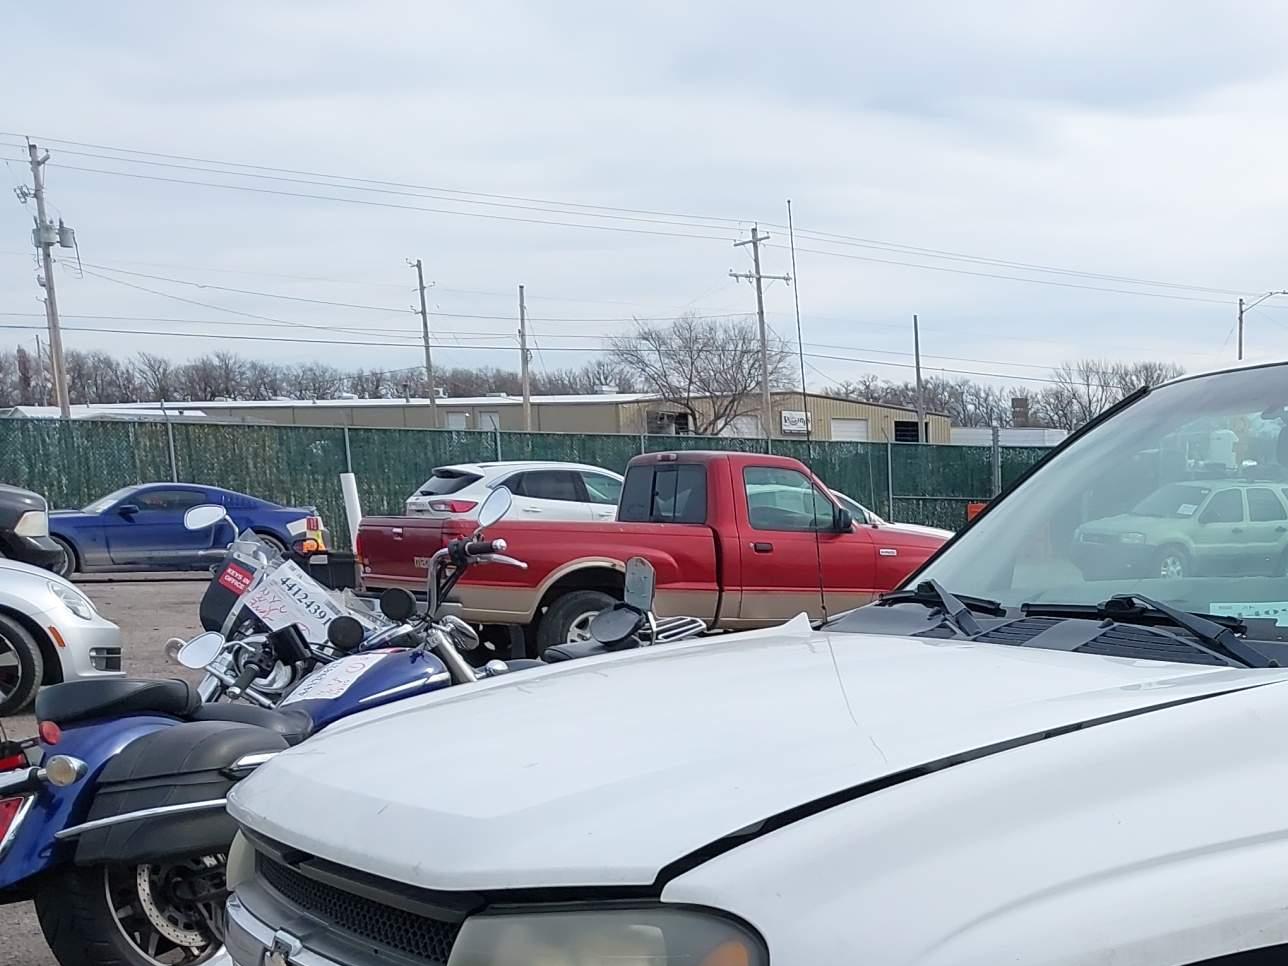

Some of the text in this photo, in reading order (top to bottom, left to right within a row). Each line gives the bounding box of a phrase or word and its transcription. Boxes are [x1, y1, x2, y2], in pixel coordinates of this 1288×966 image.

[226, 567, 243, 580] KEYS
[224, 574, 246, 591] OFFICE
[279, 575, 333, 627] 44124391
